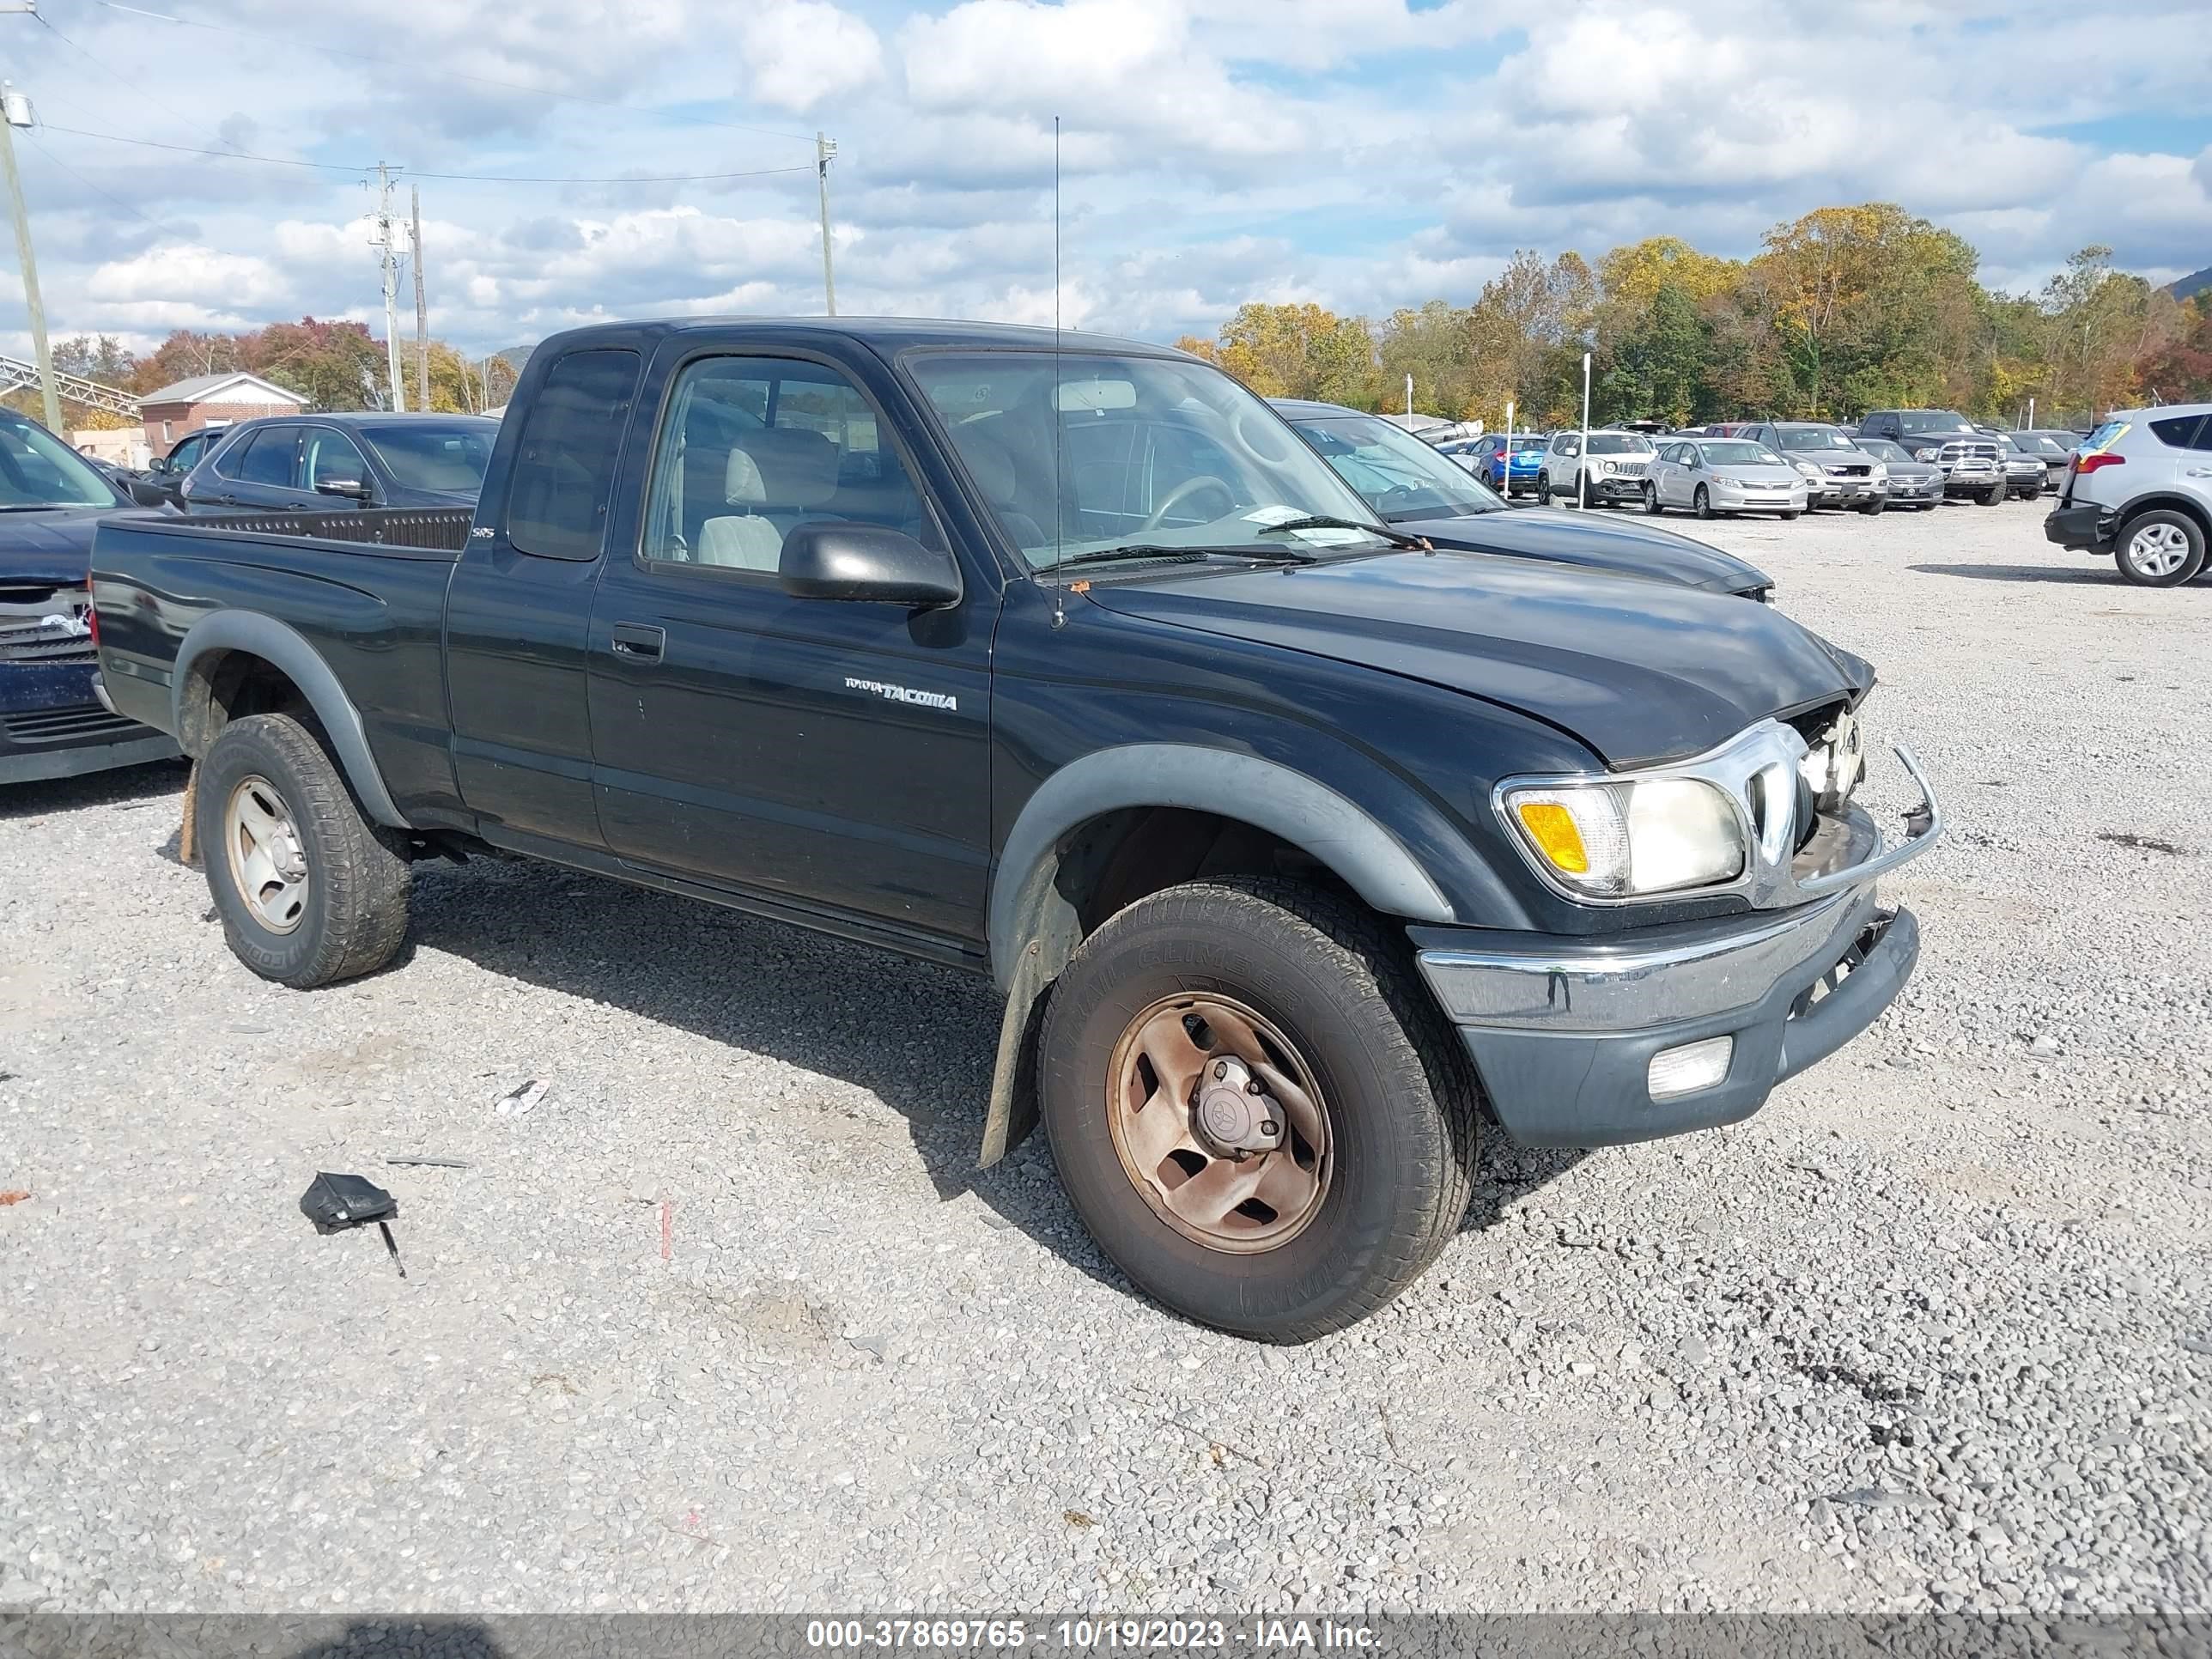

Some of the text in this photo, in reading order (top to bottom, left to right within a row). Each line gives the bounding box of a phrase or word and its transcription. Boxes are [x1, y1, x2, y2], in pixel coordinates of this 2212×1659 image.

[844, 677, 957, 711] TOYOTA TACOMA
[1134, 941, 1306, 1012] CLIMBER
